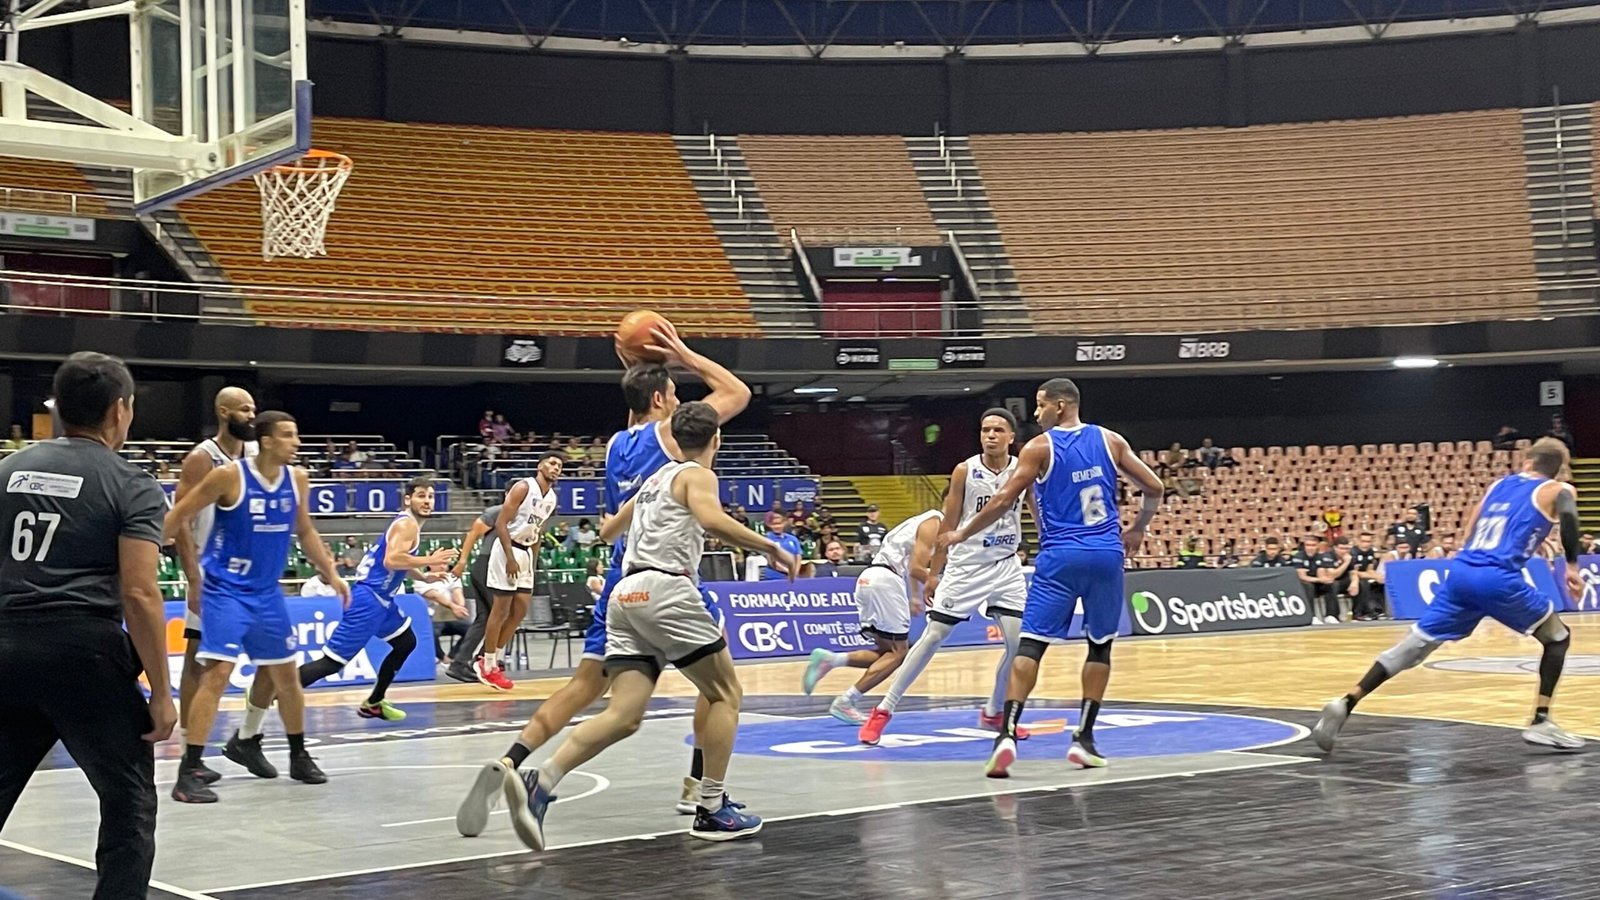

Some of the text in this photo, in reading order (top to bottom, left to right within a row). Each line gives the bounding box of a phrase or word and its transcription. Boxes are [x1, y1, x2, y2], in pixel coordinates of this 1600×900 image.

[318, 484, 764, 512] S O E N
[1080, 484, 1109, 527] 6
[11, 510, 61, 562] 67
[227, 557, 252, 576] 27
[729, 591, 809, 611] FORMAÇÃO
[811, 592, 831, 607] DE
[1168, 590, 1306, 631] Sportsbet.io
[738, 621, 794, 651] CBC
[803, 621, 845, 635] COMITÊ
